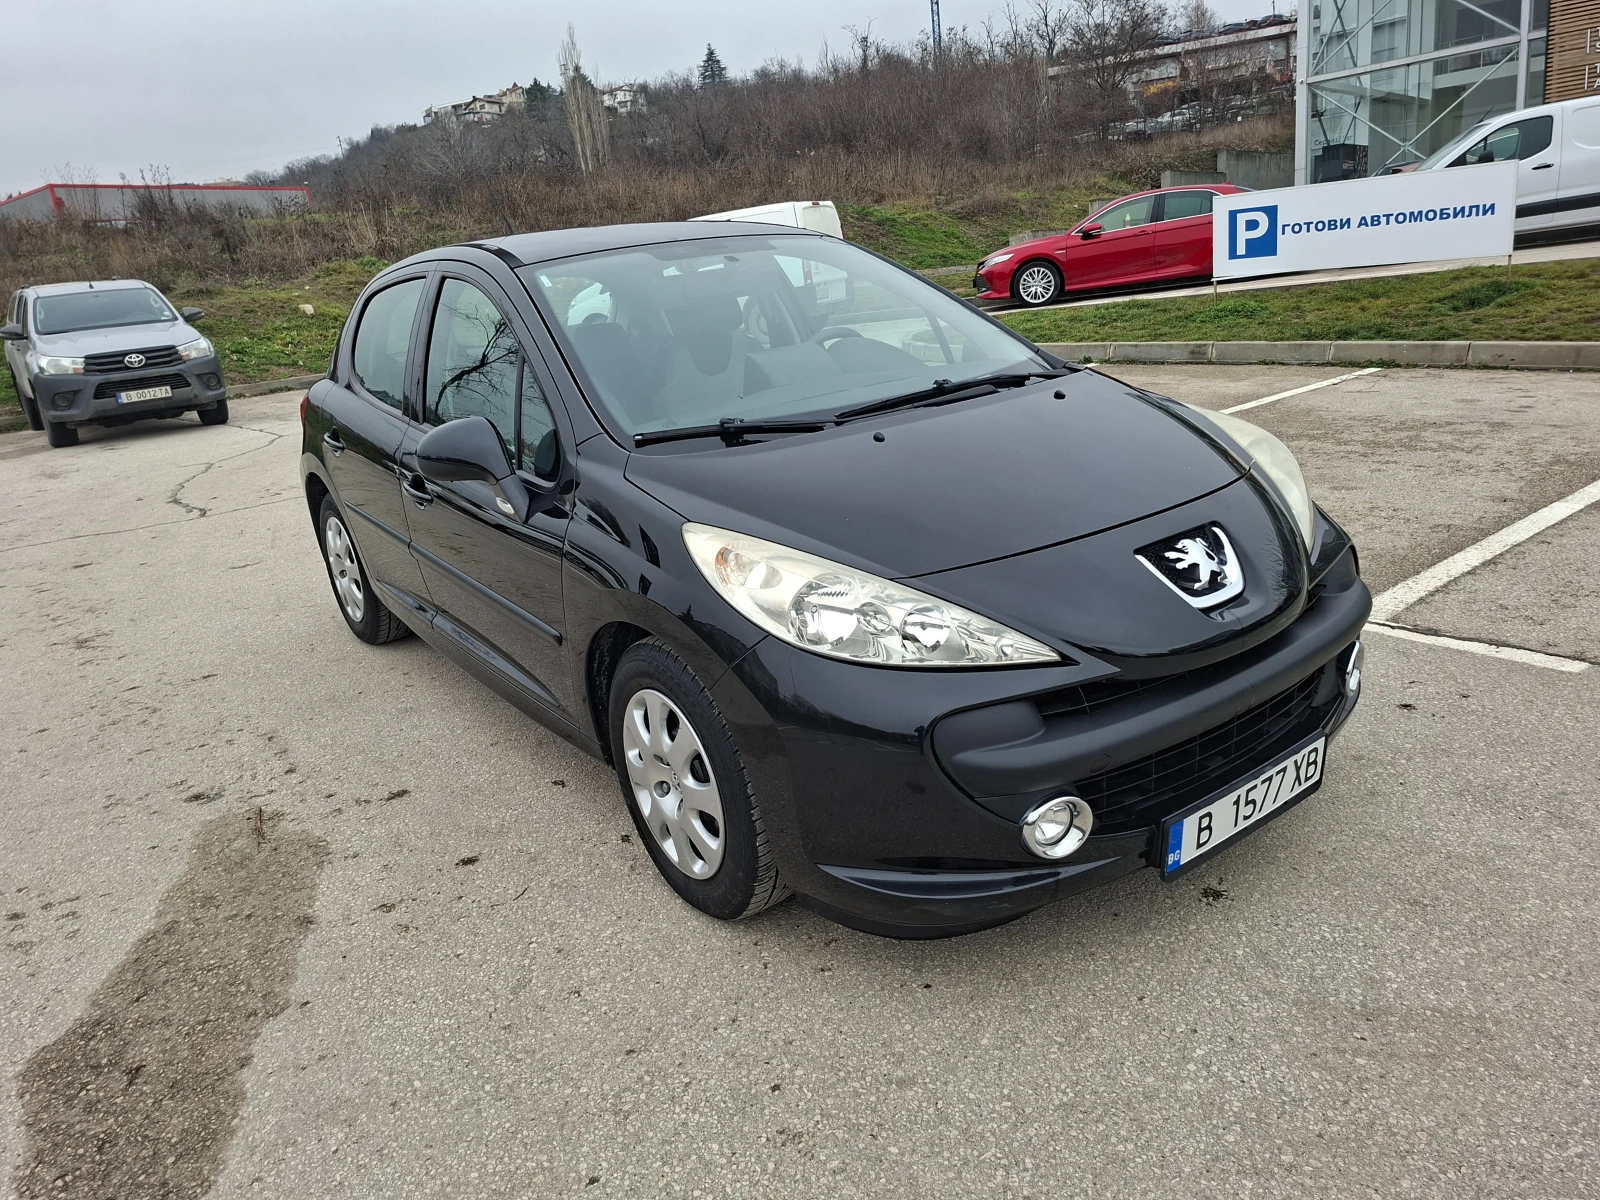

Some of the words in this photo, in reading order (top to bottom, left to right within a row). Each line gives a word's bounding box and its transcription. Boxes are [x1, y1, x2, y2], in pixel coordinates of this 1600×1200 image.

[1236, 211, 1269, 256] P
[1281, 218, 1351, 236] ГОТОВИ
[1356, 202, 1496, 229] АВТОМОБИЛИ
[1195, 811, 1214, 851] B
[1232, 765, 1289, 829] 1577
[1290, 747, 1320, 794] XB
[1168, 850, 1180, 865] BG
